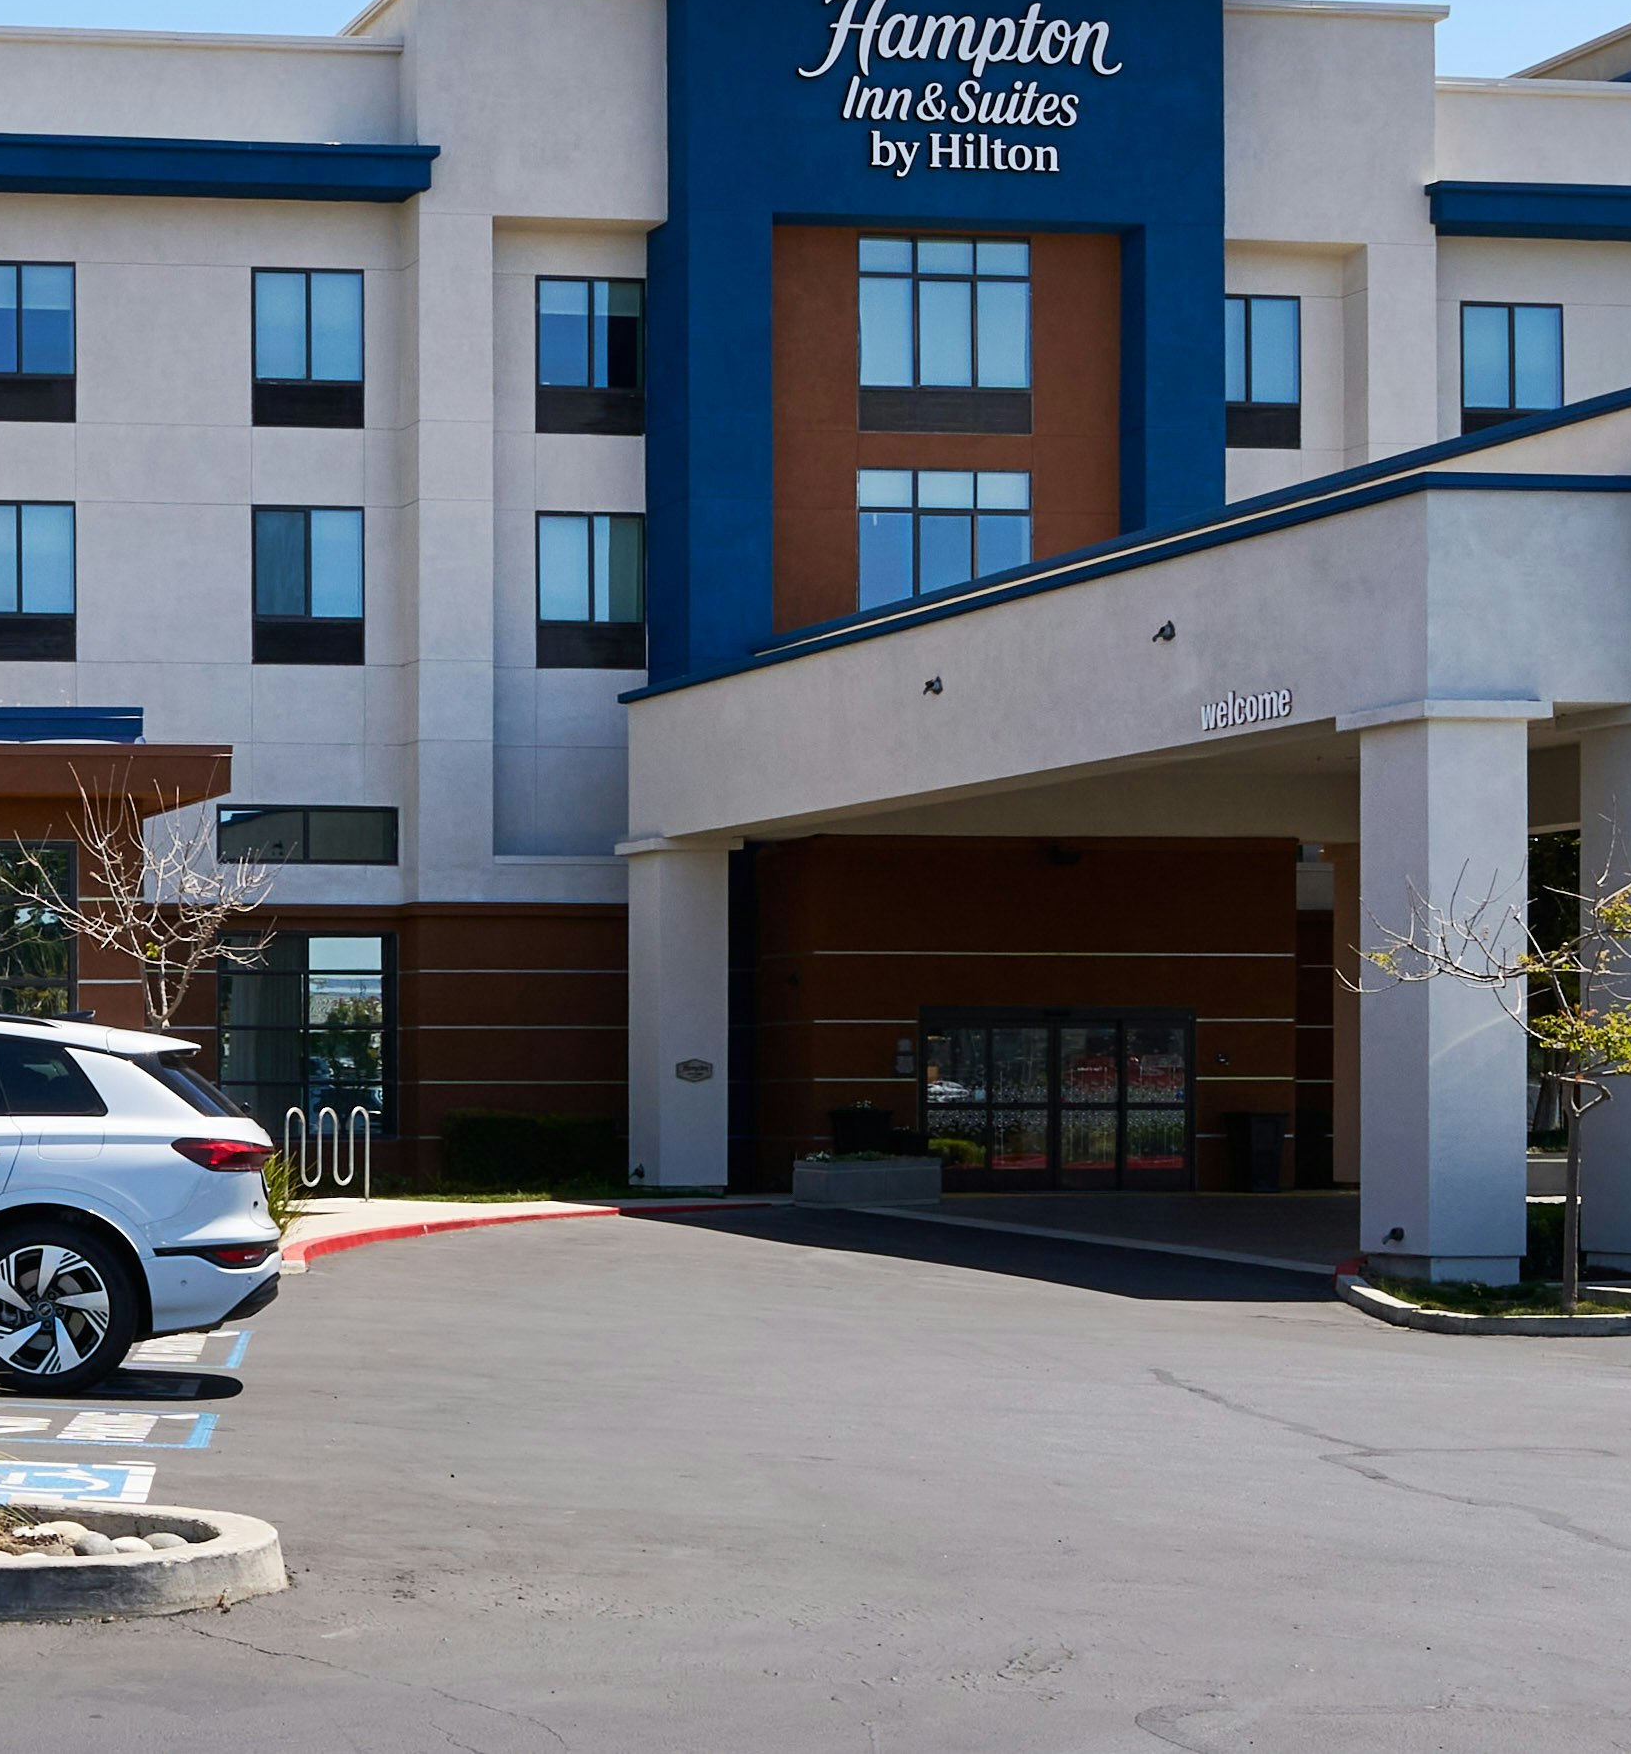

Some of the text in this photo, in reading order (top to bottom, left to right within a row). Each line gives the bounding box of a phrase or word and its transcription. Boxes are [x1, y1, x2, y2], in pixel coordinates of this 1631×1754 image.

[842, 75, 912, 121] Inn
[950, 80, 1079, 127] Suites
[870, 130, 1060, 177] by Hilton
[1201, 689, 1292, 731] welcome
